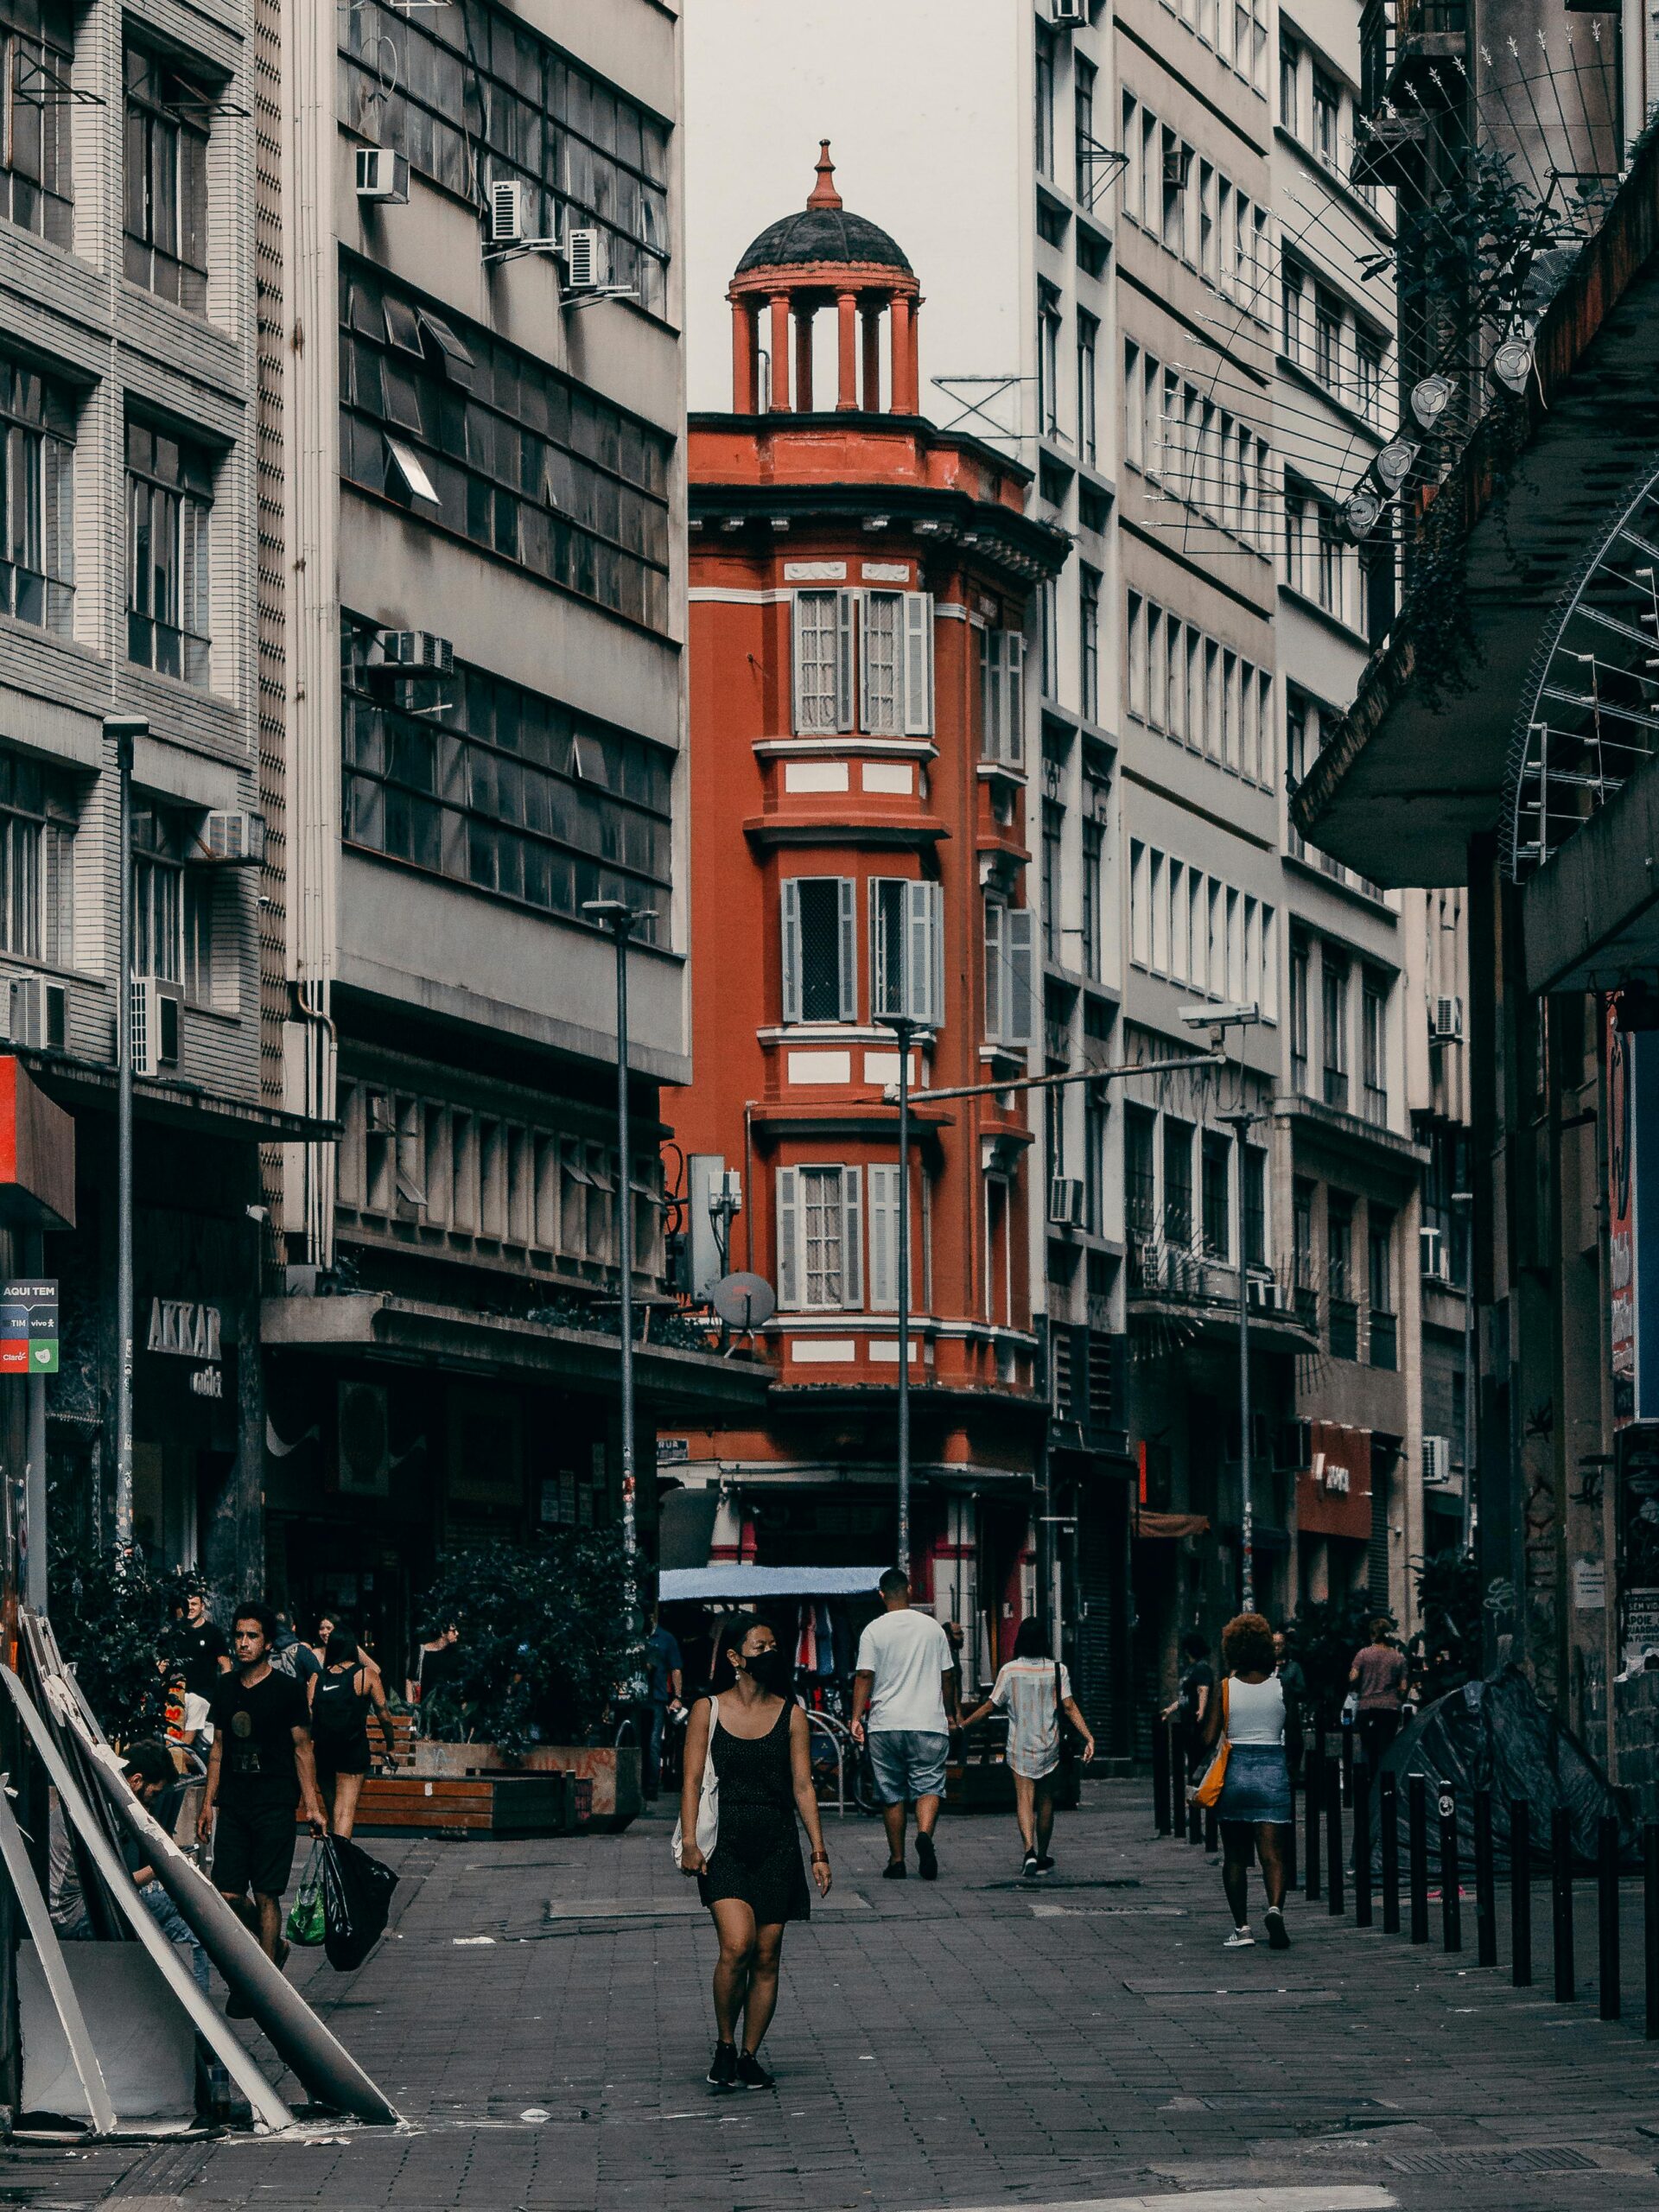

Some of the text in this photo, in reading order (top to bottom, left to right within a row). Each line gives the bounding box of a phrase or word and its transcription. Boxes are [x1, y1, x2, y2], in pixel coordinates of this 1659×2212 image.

[3, 1287, 54, 1295] AQUI TEM
[1628, 1602, 1644, 1611] SEM
